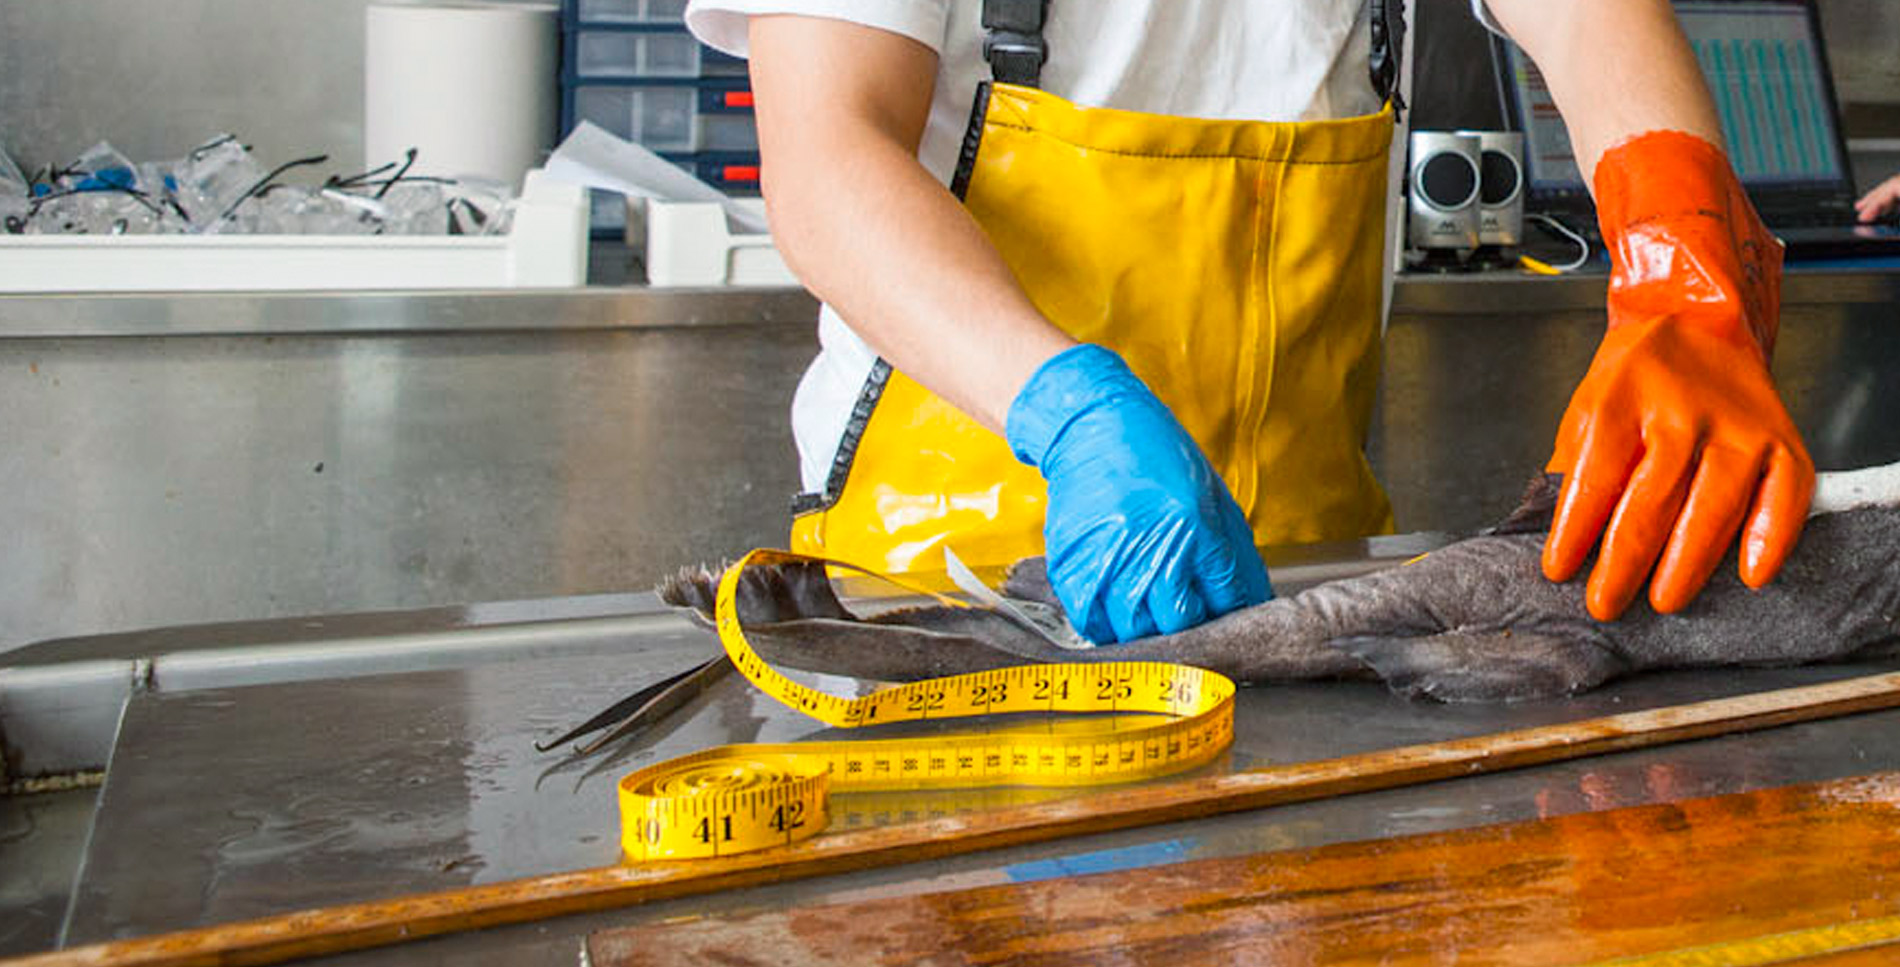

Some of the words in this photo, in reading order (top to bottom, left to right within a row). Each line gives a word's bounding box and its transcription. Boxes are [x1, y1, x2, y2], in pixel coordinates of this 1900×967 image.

[907, 692, 944, 711] 22
[971, 683, 1008, 707] 23
[1033, 679, 1069, 701] 24
[1096, 679, 1132, 701] 25
[1158, 681, 1192, 704] 26
[692, 816, 735, 843] 41
[769, 800, 805, 832] 42
